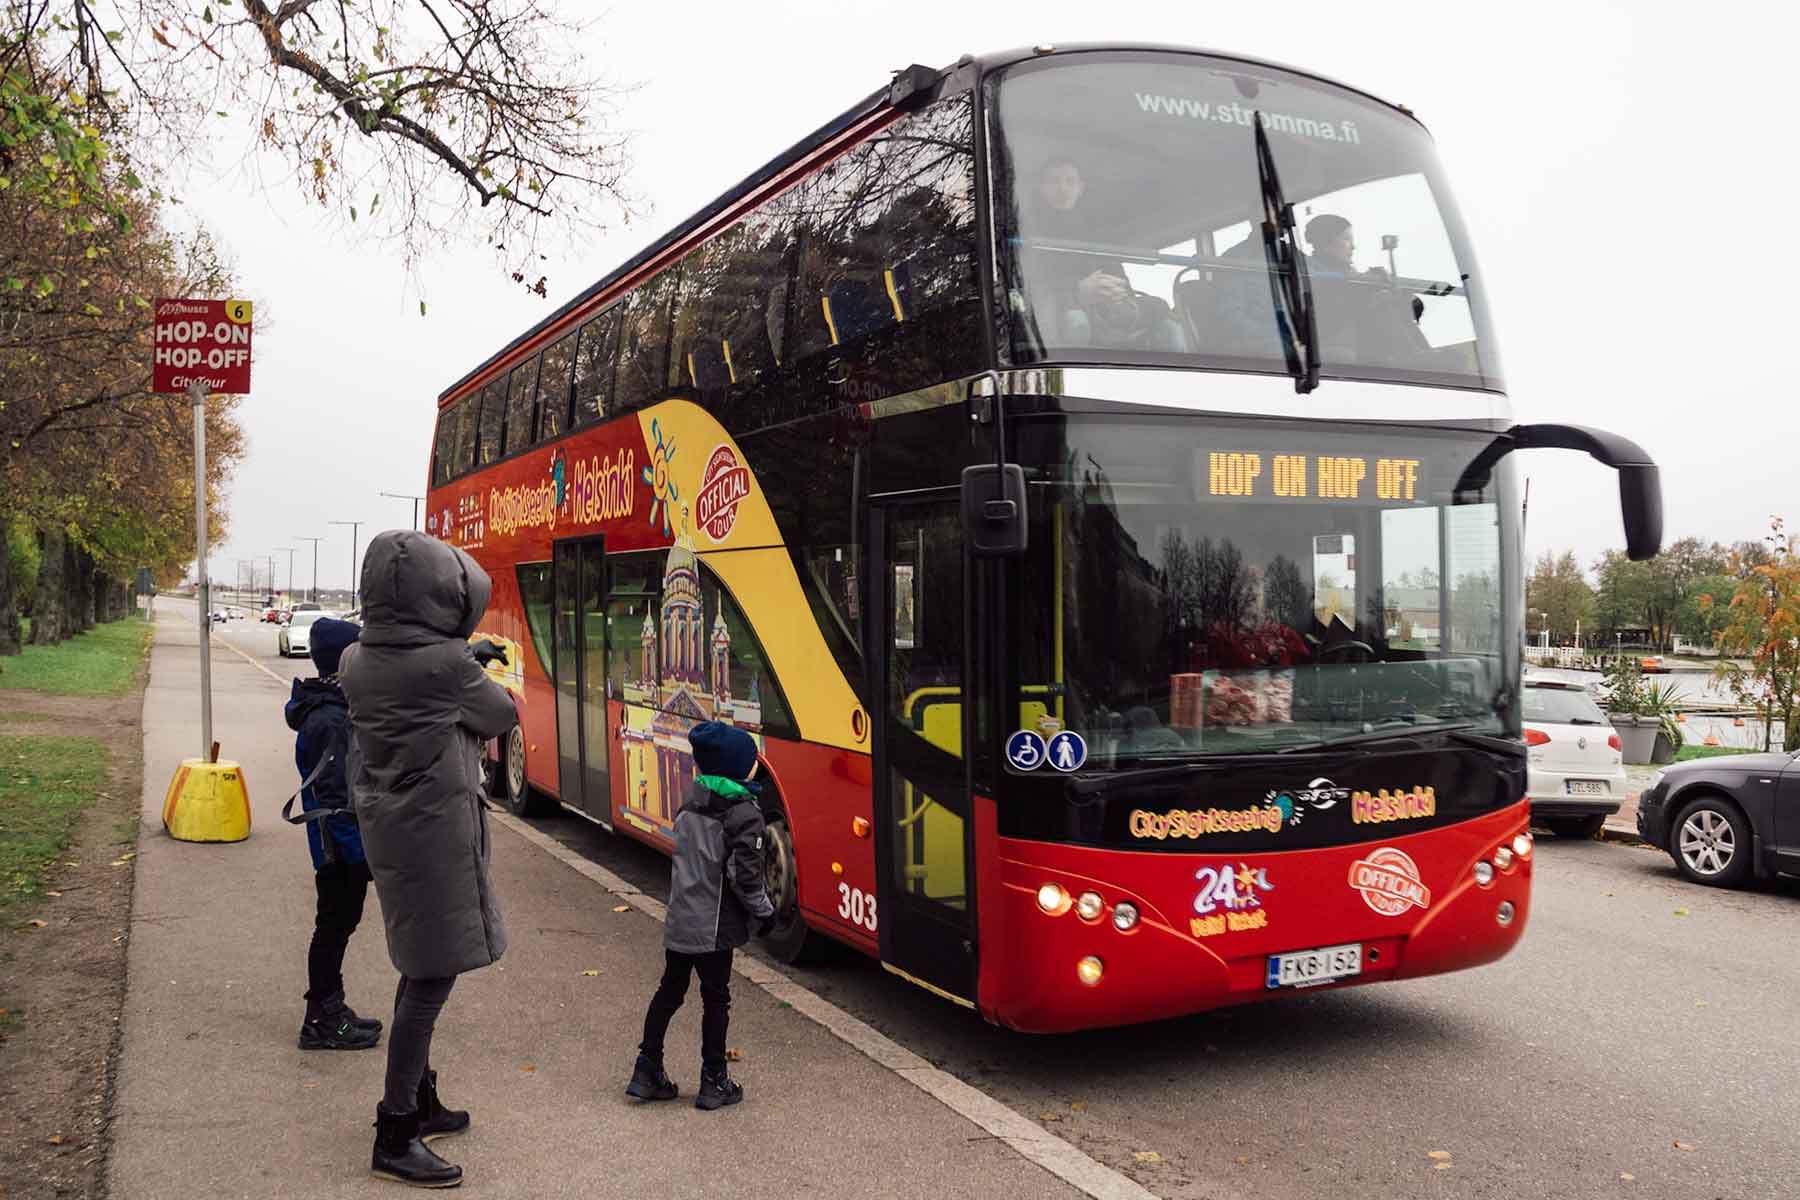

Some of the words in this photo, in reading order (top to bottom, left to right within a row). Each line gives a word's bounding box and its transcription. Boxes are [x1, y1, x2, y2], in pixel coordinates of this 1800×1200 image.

[1136, 92, 1361, 145] www.stromma.fi
[156, 321, 249, 344] HOP-ON
[234, 305, 244, 319] 6
[155, 347, 249, 369] HOP-OFF
[573, 447, 634, 525] Helsinki
[700, 471, 747, 522] OFFICIAL
[1209, 452, 1261, 495] HOP
[1273, 455, 1306, 496] ON
[1318, 456, 1366, 497] HOP
[1377, 459, 1420, 499] OFF
[1352, 785, 1436, 824] Helsinki
[838, 881, 878, 931] 303
[1193, 864, 1237, 913] 24
[1359, 867, 1425, 905] OFFICIAL
